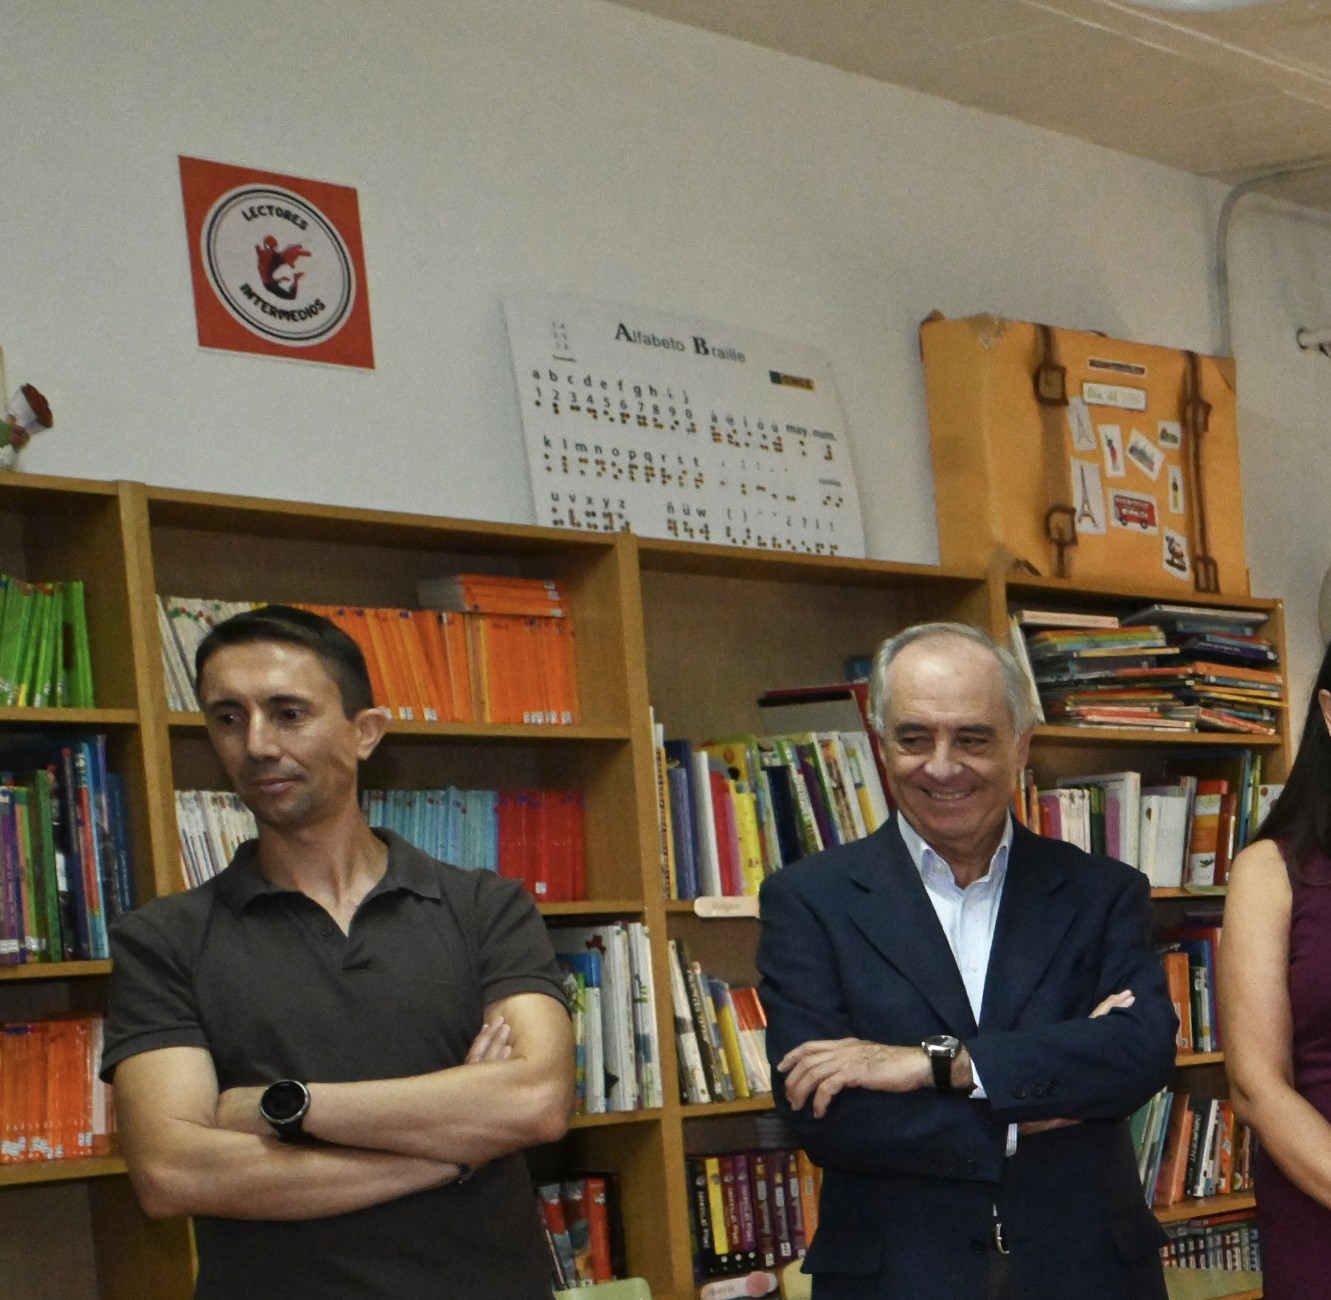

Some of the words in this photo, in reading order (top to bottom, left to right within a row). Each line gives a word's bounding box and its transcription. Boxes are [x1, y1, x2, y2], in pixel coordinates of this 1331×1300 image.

[242, 205, 309, 230] LECTORES
[239, 283, 326, 322] INTERMEDIOS
[615, 322, 685, 352] Alfabeto
[692, 335, 746, 362] Braille
